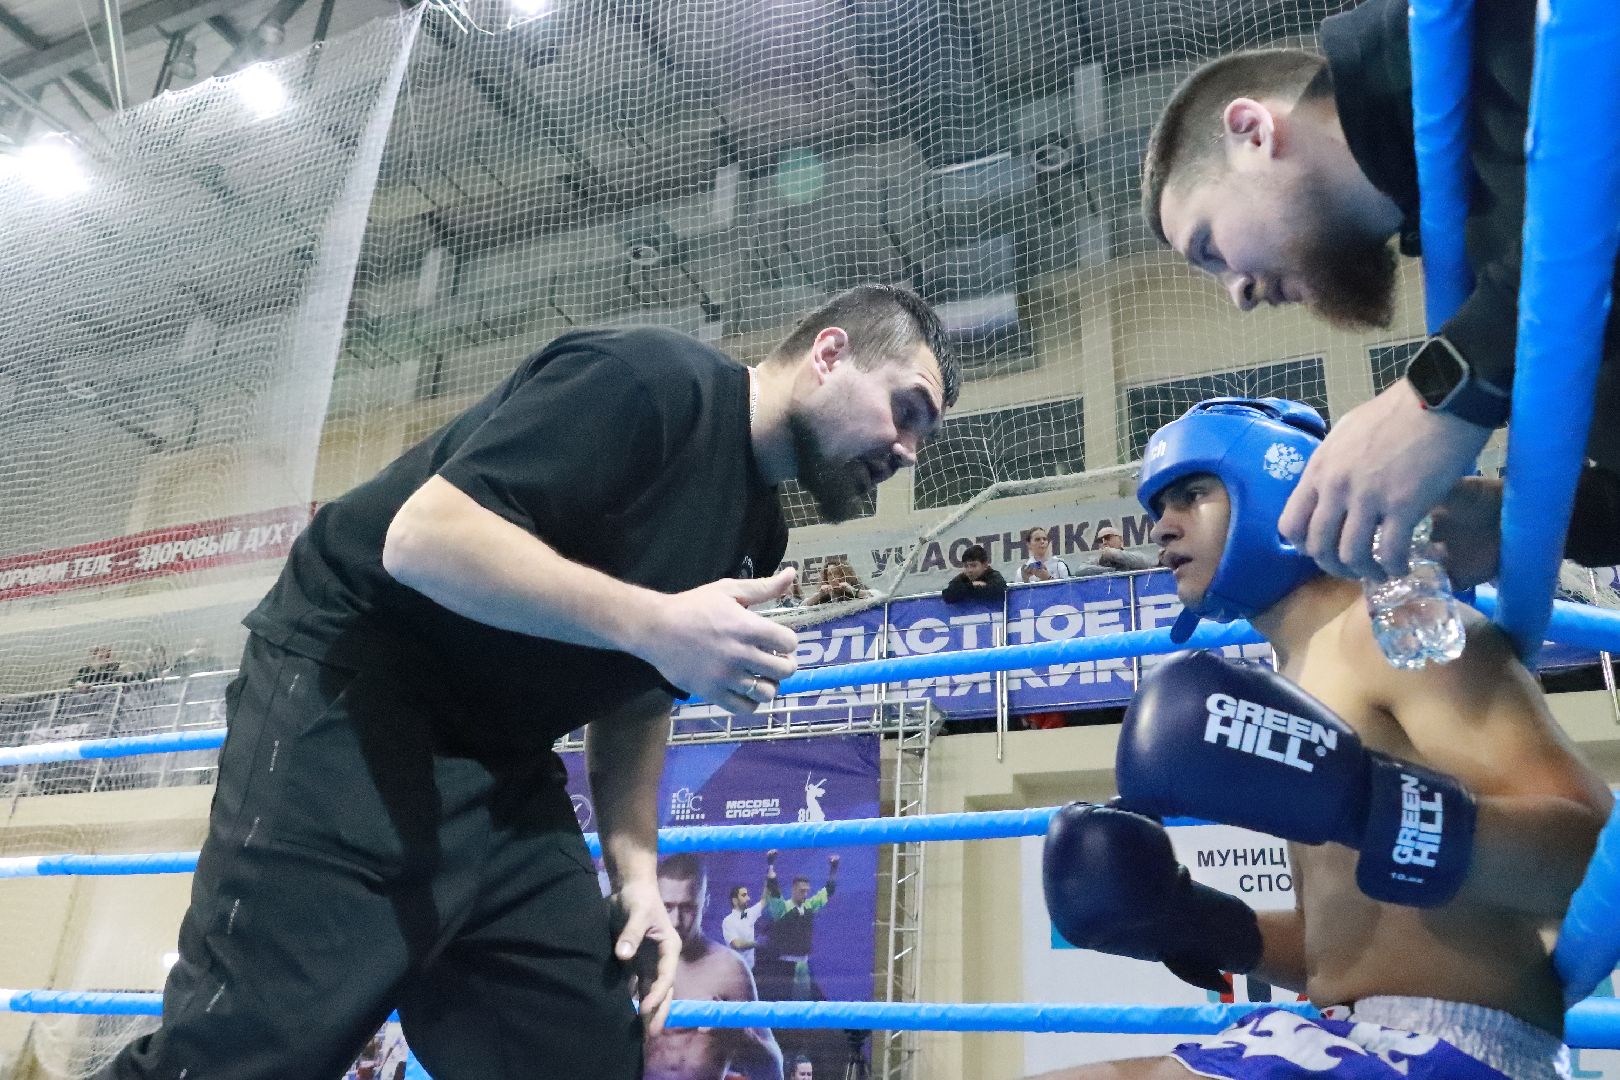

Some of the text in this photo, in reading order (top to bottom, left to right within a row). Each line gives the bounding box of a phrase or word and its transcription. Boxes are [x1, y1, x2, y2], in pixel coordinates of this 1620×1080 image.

[134, 528, 241, 570] ЗДОРОВЫЙ
[795, 598, 1124, 665] БЛАСТНОЕ
[1204, 713, 1314, 773] HILL
[1206, 693, 1338, 751] GREEN
[1392, 773, 1420, 865] GREEN
[1411, 792, 1443, 868] HILL
[1197, 848, 1286, 868] МУНИЦ
[1240, 873, 1293, 892] СПО
